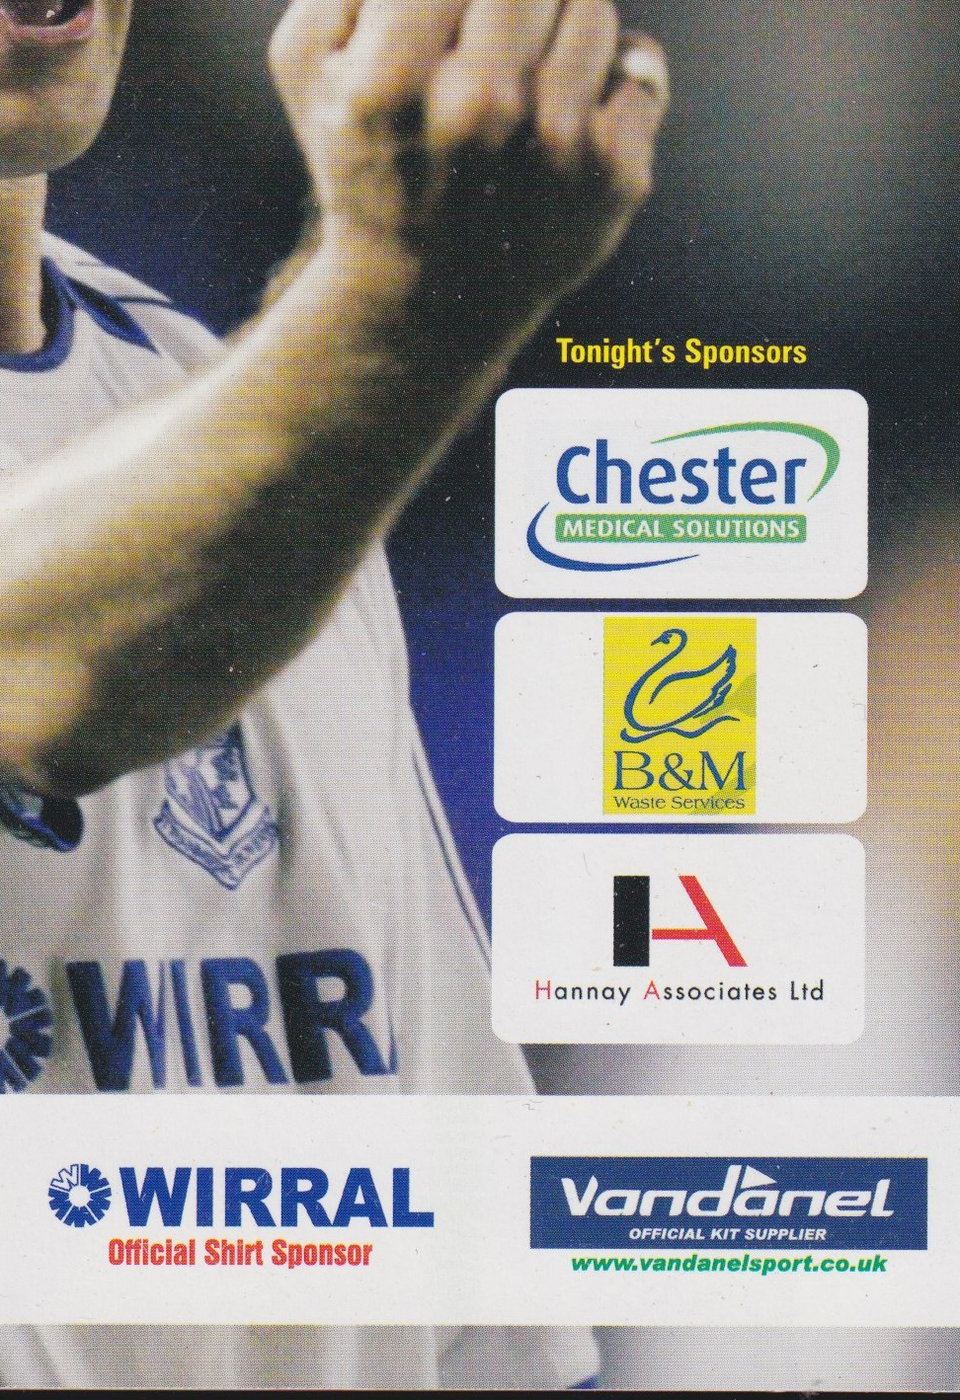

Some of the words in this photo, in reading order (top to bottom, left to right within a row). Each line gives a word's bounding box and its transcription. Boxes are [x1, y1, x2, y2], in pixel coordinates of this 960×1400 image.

[556, 338, 676, 369] Tonight's
[685, 338, 807, 369] Sponsors
[556, 439, 807, 505] Chester
[562, 519, 665, 539] MEDICAL
[672, 519, 801, 539] SOLUTIONS
[613, 750, 747, 792] B&M
[613, 796, 667, 810] Waste
[671, 796, 746, 810] Services
[535, 979, 631, 1006] Hannay
[643, 981, 777, 1001] Associates
[790, 979, 824, 1001] Ltd
[66, 948, 398, 1092] WIRR
[119, 1167, 435, 1228] WIRRAL
[561, 1164, 895, 1217] Vandanel
[628, 1227, 706, 1241] OFFICIAL
[710, 1228, 741, 1241] KIT
[744, 1228, 827, 1241] SUPPLIER
[108, 1238, 196, 1266] Official
[204, 1238, 264, 1266] Shirt
[271, 1239, 373, 1269] Sponsor
[571, 1254, 888, 1277] www.vandanelsport.co.uk
